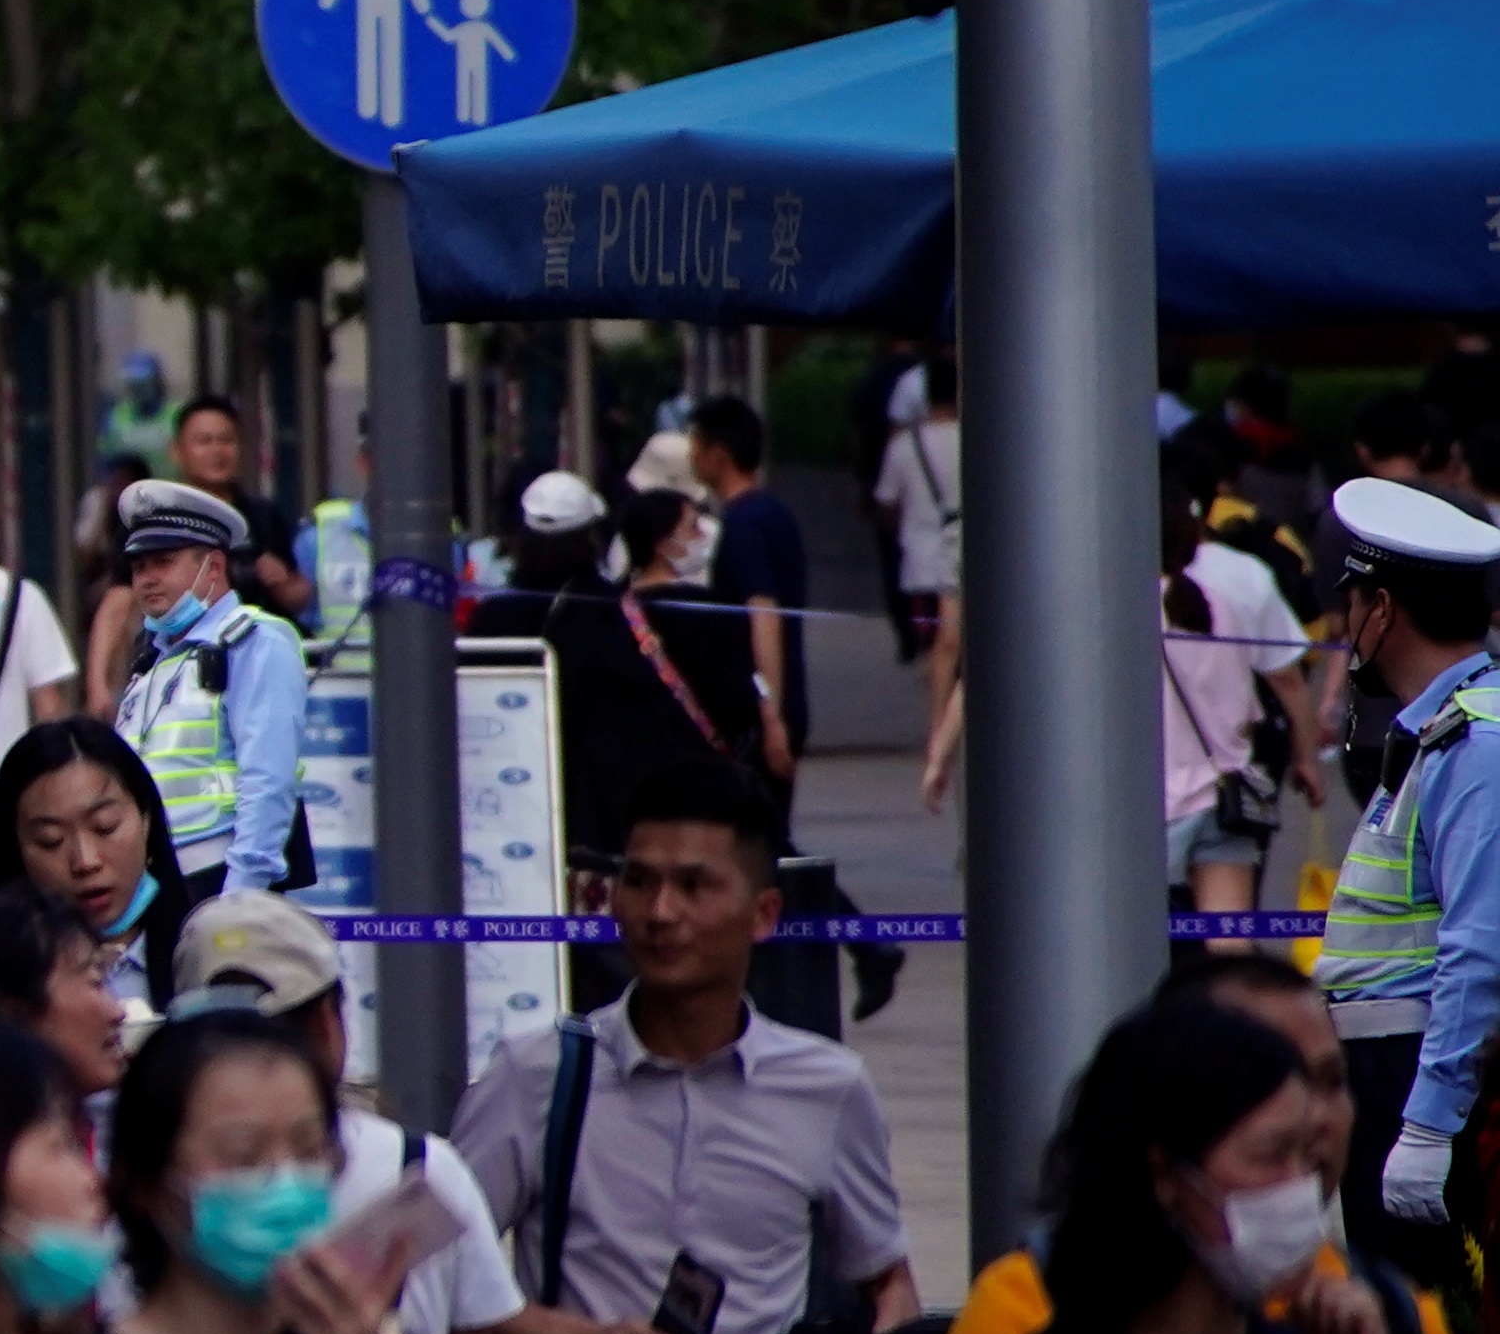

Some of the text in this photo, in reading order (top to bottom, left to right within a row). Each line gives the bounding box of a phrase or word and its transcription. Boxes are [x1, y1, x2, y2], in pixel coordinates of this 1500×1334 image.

[596, 181, 746, 291] POLICE
[352, 920, 422, 937] POLICE
[484, 920, 553, 937] POLICE
[876, 920, 946, 936] POLICE
